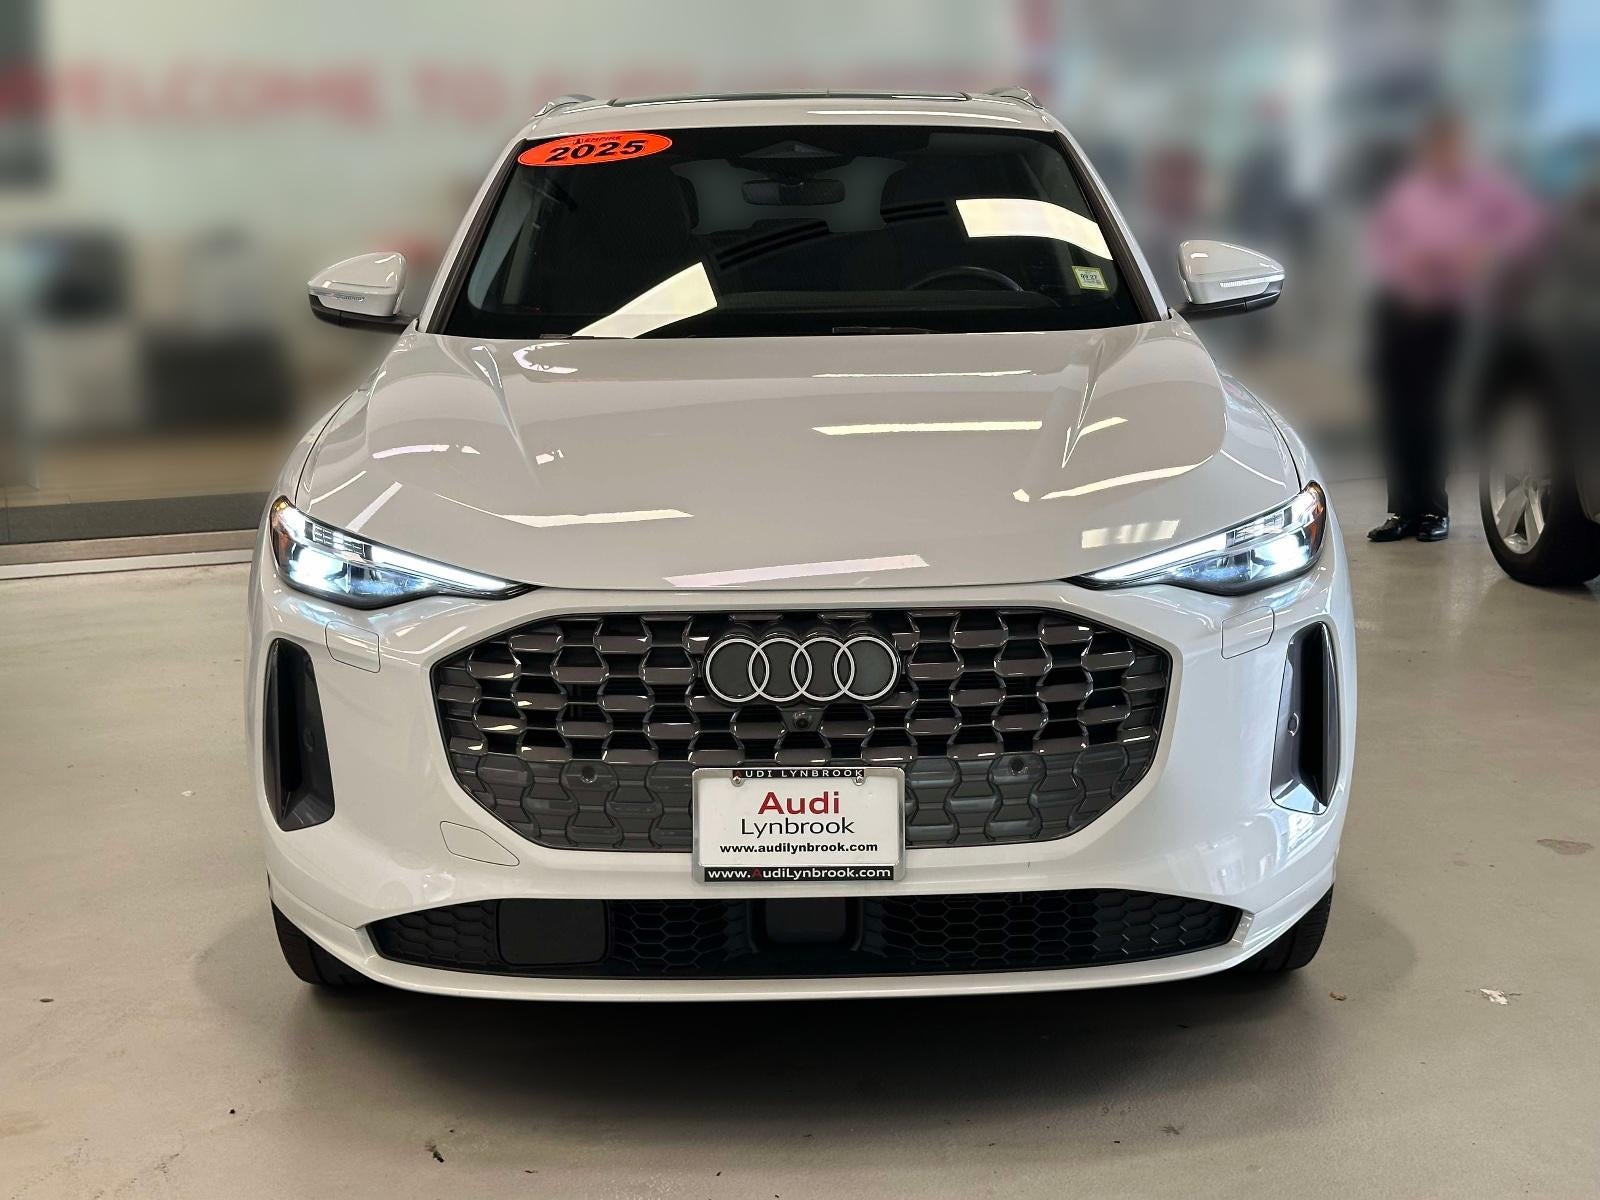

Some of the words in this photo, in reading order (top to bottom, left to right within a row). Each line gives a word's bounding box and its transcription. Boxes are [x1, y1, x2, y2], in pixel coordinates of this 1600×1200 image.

[545, 140, 647, 163] 2025
[736, 770, 772, 778] AUDI
[782, 769, 863, 778] LYNBROOK
[758, 791, 840, 814] Audi
[741, 817, 855, 838] Lynbrook
[720, 843, 878, 854] www.audilynbrook.com
[708, 868, 891, 881] www.AudiLynbrook.com
